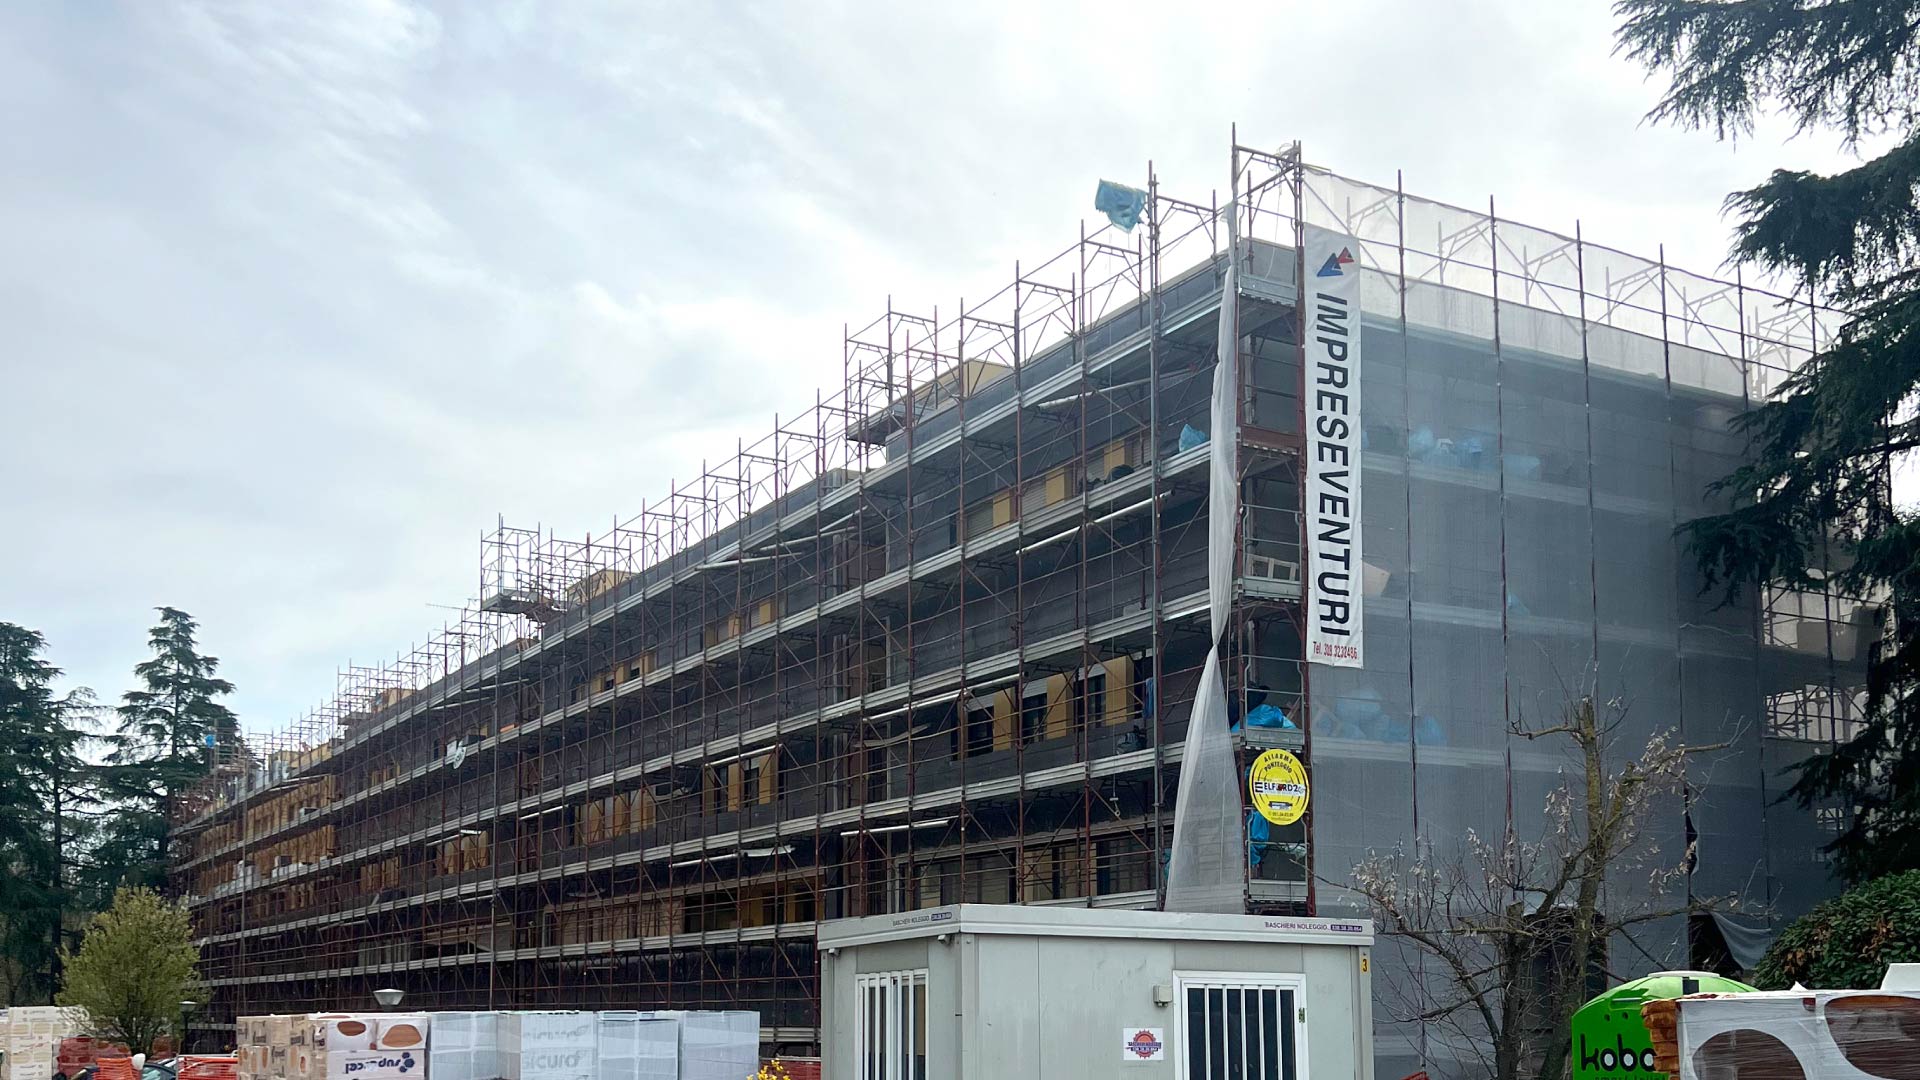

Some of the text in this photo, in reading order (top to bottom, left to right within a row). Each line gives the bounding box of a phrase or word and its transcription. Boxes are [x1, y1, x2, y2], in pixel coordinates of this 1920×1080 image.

[1316, 292, 1351, 636] IMPRESEVENTURI
[1264, 753, 1293, 764] ALLARME
[1264, 761, 1293, 773] PONTEGGIO
[1264, 921, 1296, 929] BASCHIERI
[1362, 958, 1368, 972] 3
[345, 1058, 401, 1074] supcel
